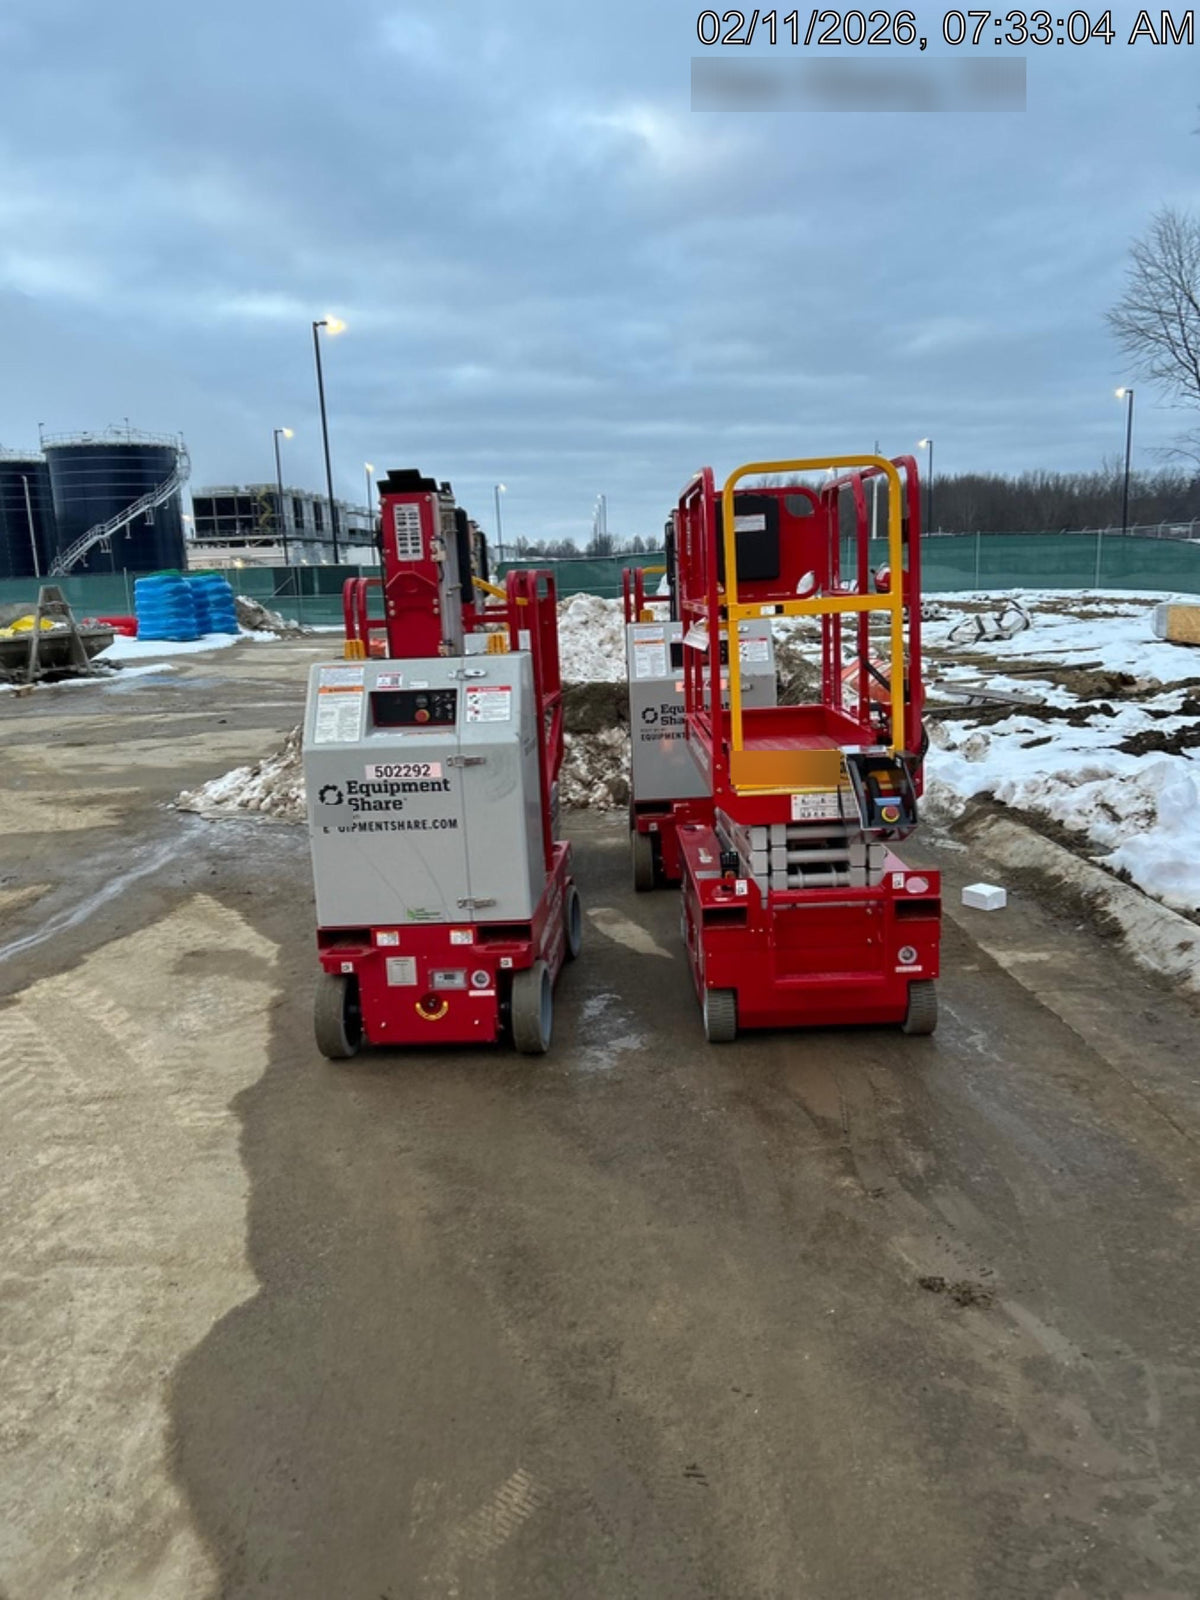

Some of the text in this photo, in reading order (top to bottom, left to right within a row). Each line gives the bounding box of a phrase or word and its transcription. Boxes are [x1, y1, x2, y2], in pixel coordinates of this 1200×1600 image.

[661, 716, 686, 726] Sha
[374, 764, 431, 778] 502292
[346, 779, 451, 797] Equipment
[347, 797, 403, 811] Share
[323, 818, 458, 834] EUIPMENTSHARE.COM
